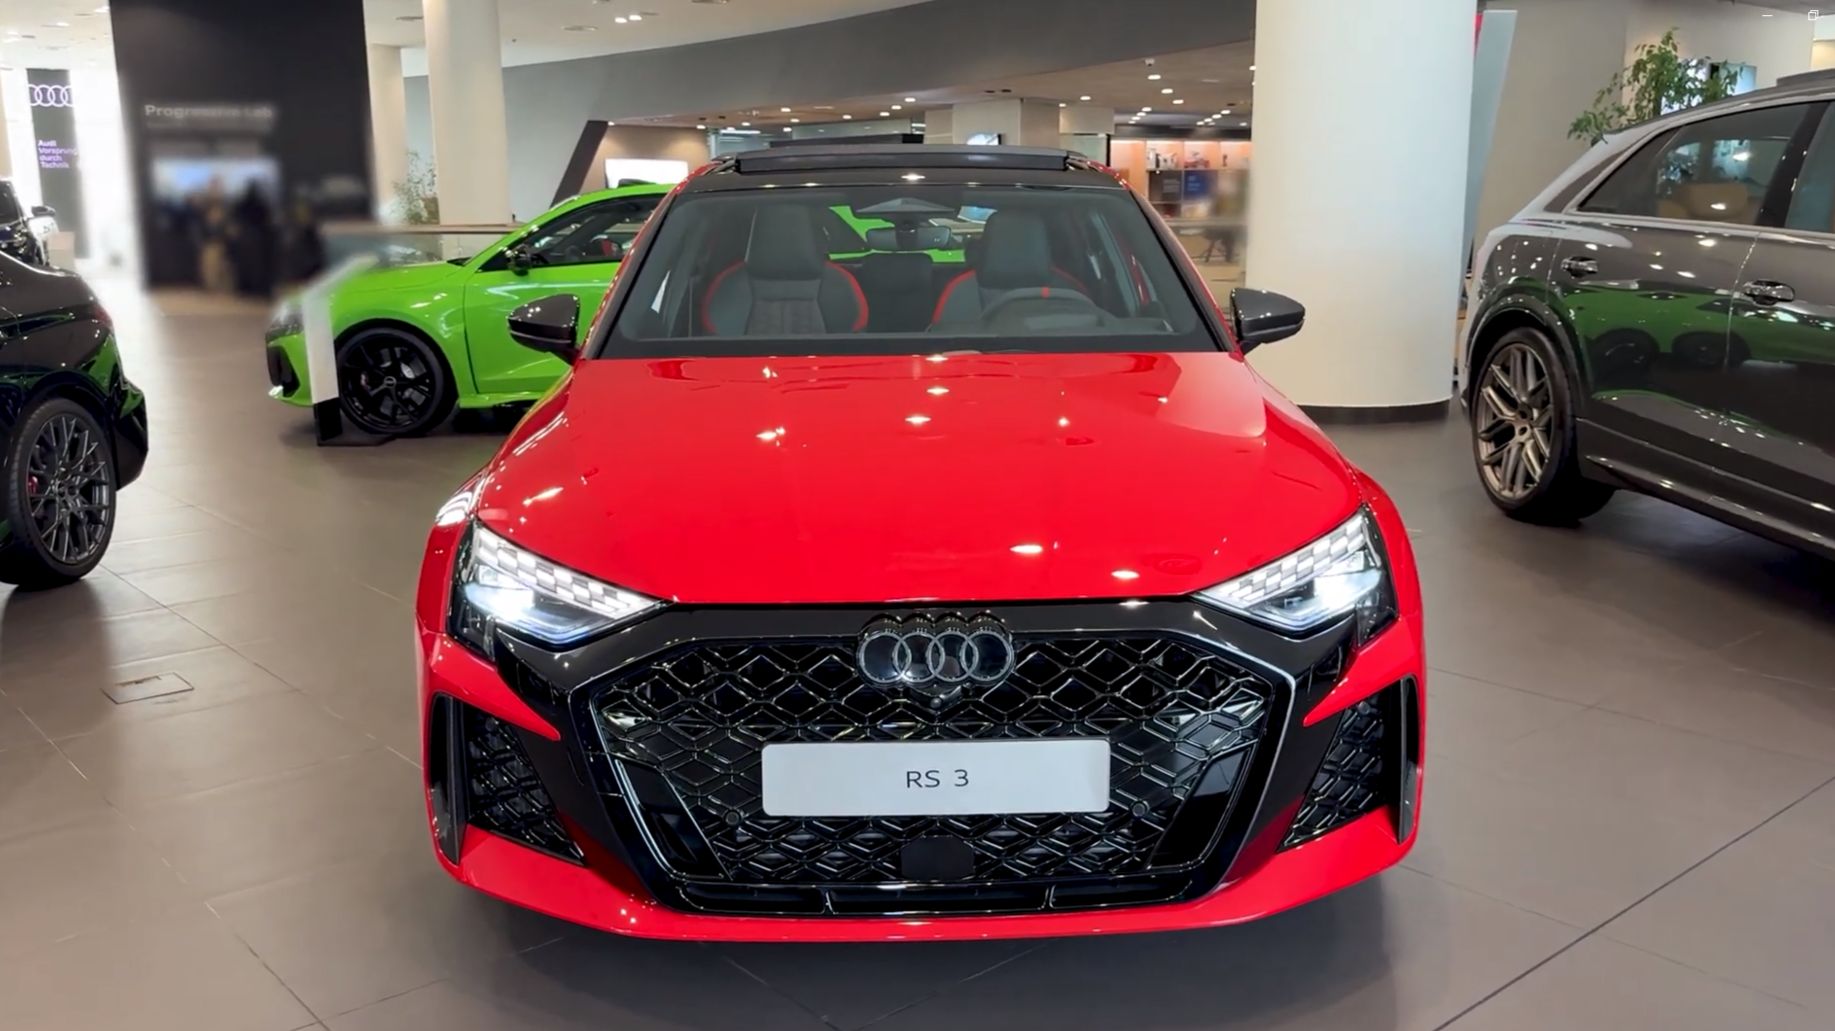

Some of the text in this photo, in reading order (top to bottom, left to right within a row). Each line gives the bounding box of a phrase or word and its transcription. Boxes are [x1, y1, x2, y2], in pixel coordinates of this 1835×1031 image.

[144, 104, 241, 119] Progre
[906, 768, 969, 788] RS 3
